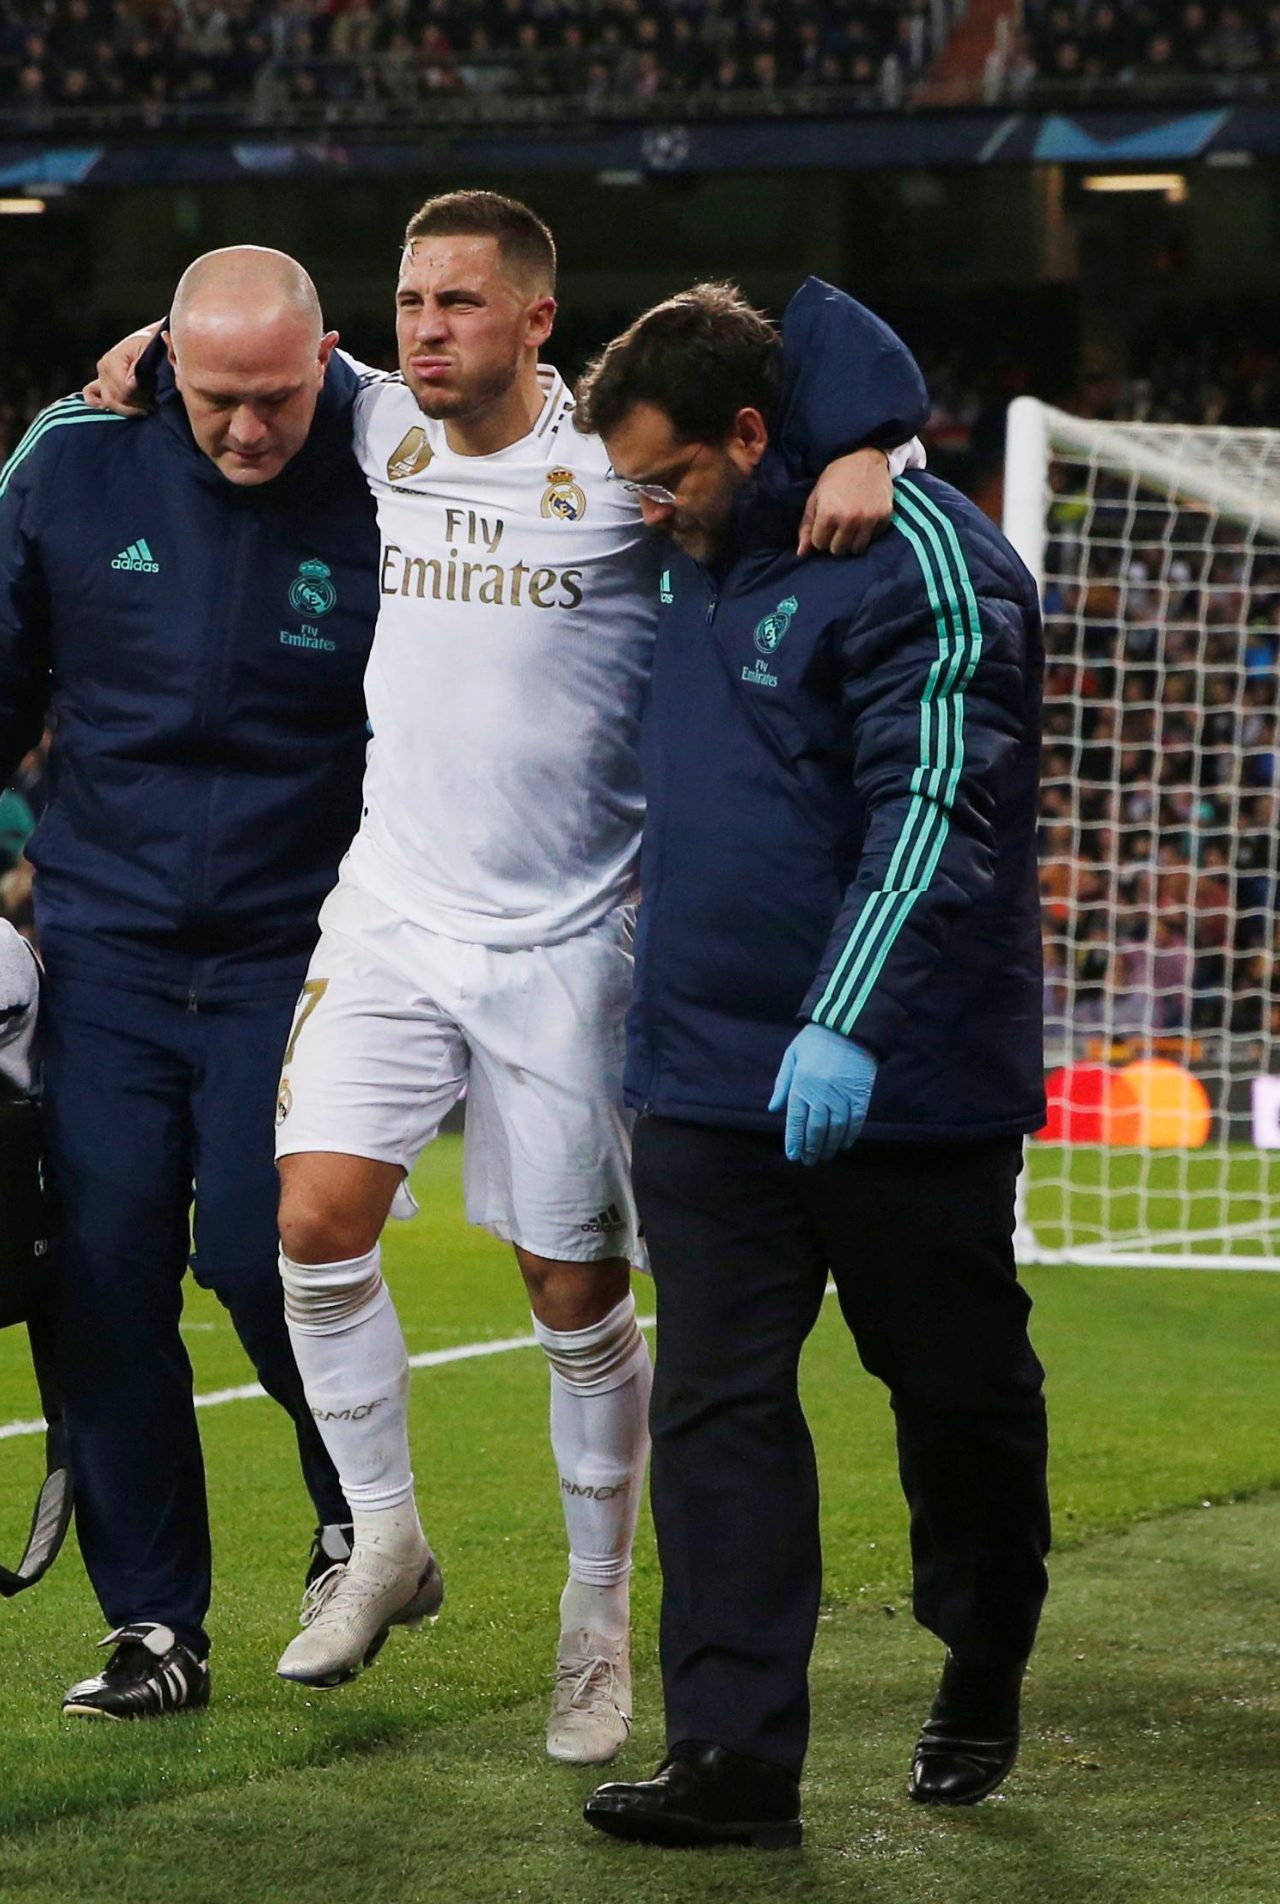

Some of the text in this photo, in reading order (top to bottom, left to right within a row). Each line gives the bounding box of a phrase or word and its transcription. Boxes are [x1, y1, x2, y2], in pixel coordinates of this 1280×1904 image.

[444, 508, 504, 553] Fly
[110, 557, 160, 573] adidas
[381, 545, 583, 609] Emirates
[301, 624, 319, 637] Fly
[279, 631, 336, 651] Emirates
[755, 659, 769, 672] Fly
[741, 666, 778, 687] Emirates
[282, 978, 330, 1066] 7
